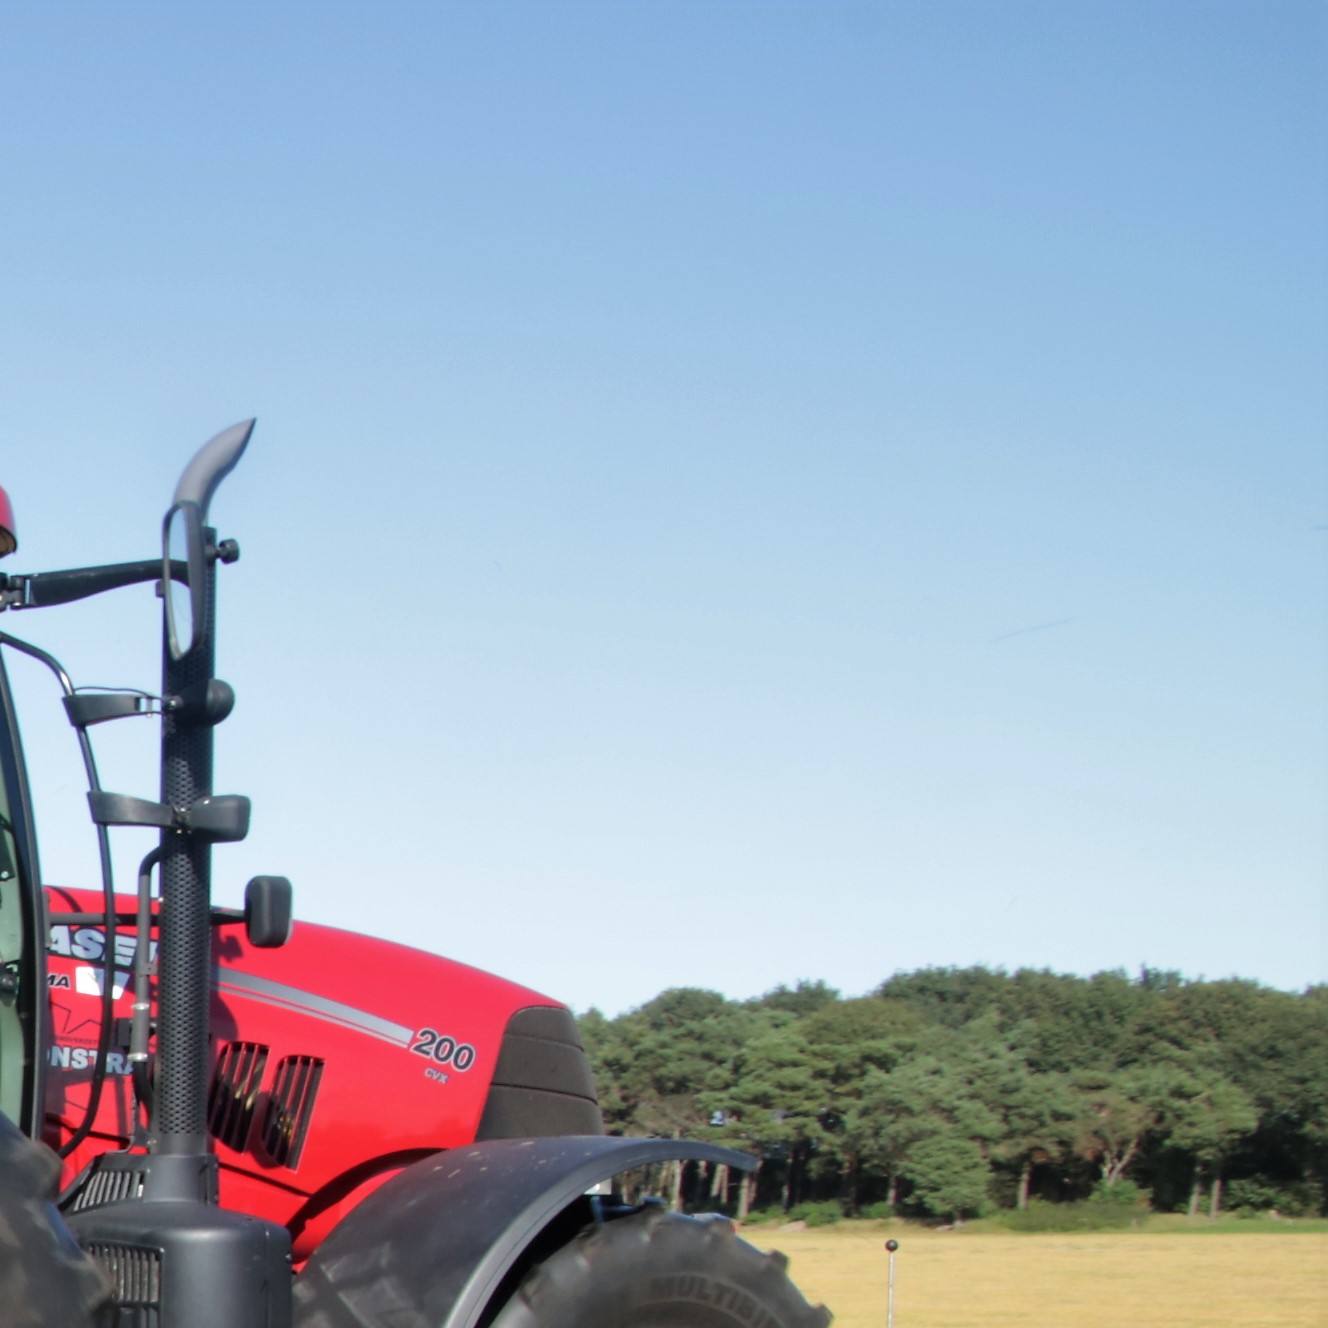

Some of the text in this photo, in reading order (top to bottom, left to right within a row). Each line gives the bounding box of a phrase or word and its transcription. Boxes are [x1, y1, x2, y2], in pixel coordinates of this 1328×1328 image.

[50, 925, 137, 966] ASE
[410, 1028, 475, 1072] 200
[424, 1067, 449, 1084] CVX
